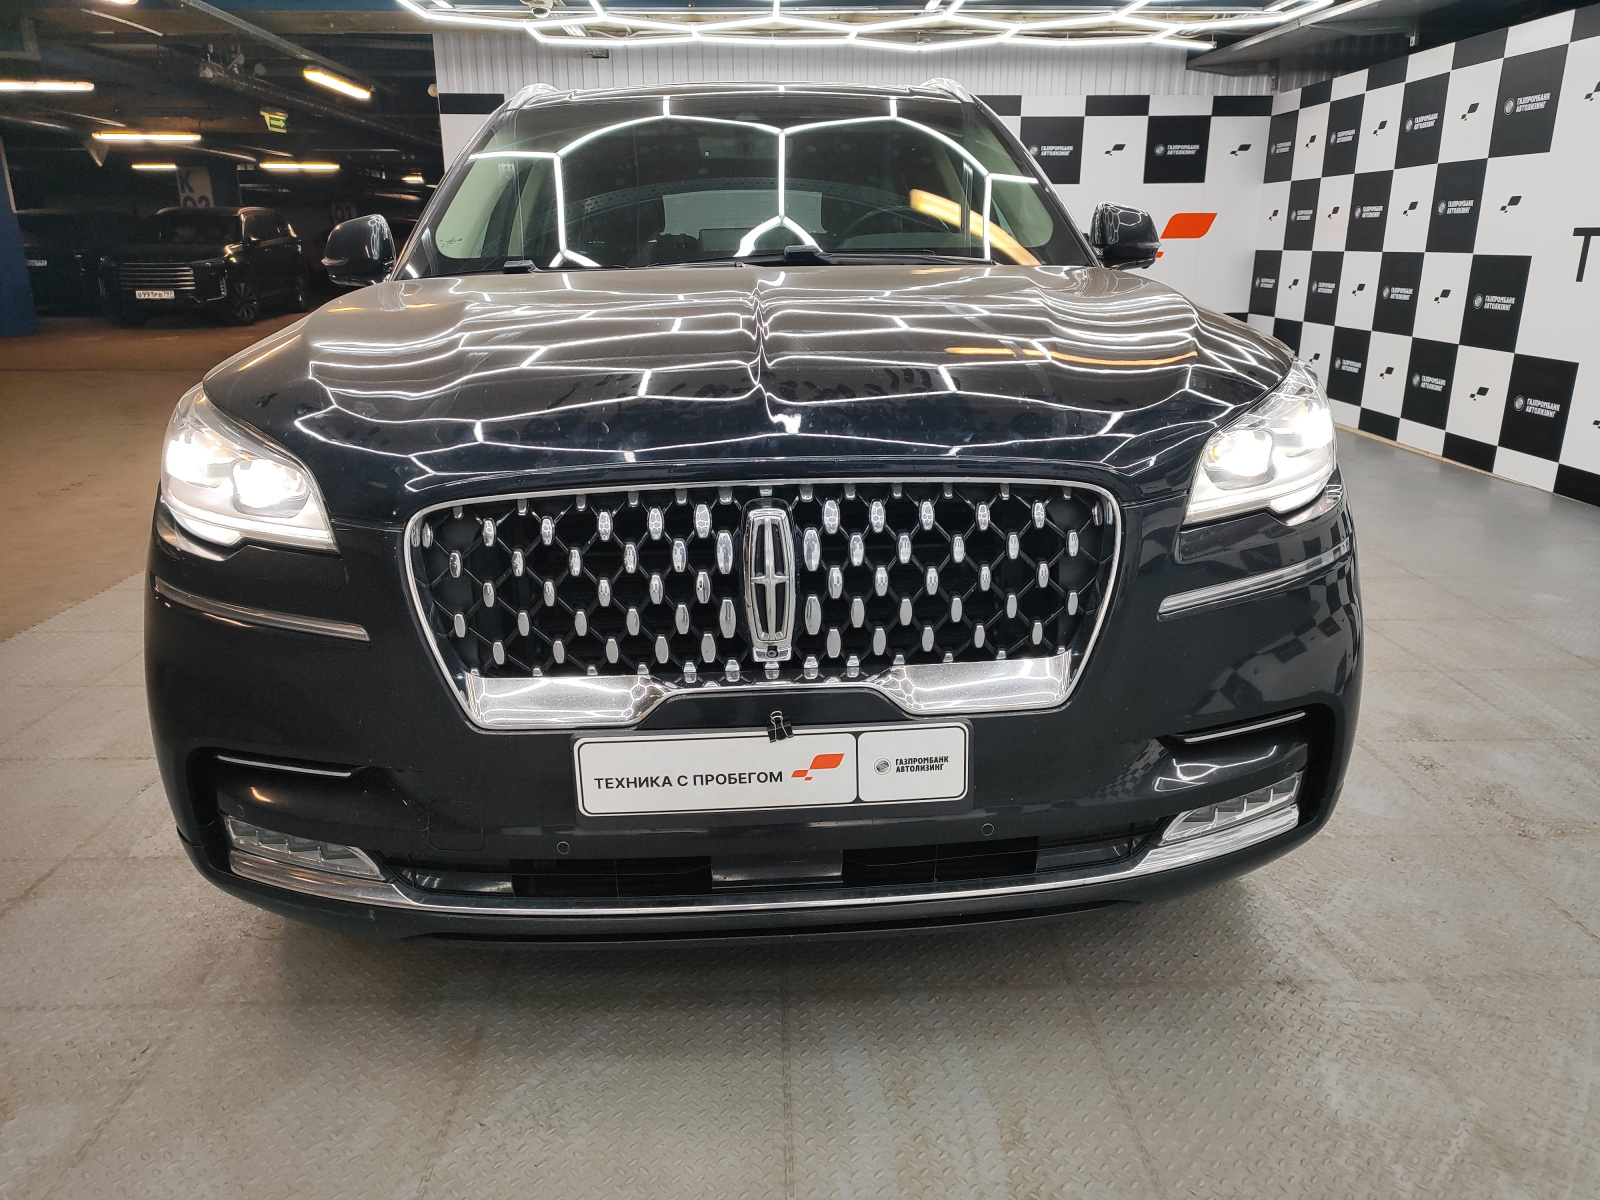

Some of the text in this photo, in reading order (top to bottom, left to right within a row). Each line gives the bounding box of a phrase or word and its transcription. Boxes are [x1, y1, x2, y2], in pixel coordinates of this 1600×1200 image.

[896, 756, 949, 765] ГАЗПРОМБАНК
[896, 764, 944, 773] АВТОЛИЗИНГ
[594, 771, 783, 789] ТЕХНИКА С ПРОБЕГОМ
